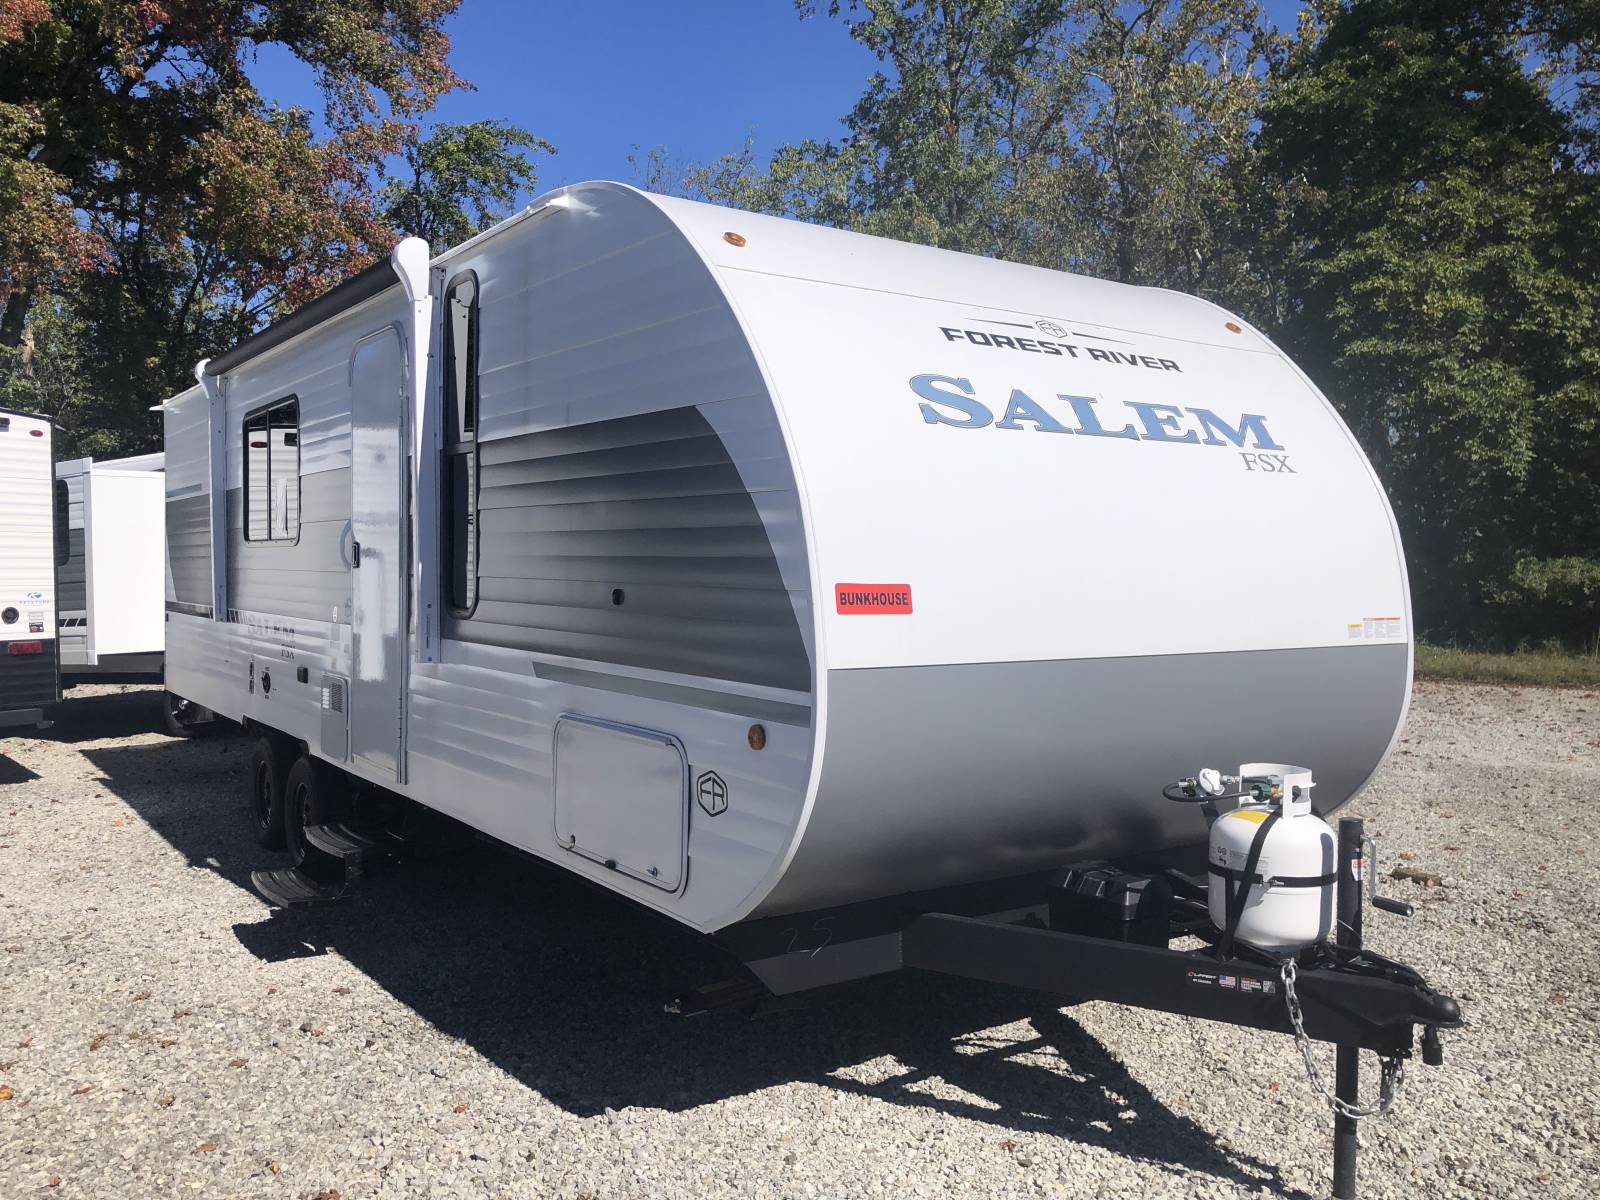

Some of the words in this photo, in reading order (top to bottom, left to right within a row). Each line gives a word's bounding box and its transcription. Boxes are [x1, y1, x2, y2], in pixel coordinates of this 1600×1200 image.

[938, 326, 1078, 358] FOREST
[1084, 347, 1184, 373] RIVER
[908, 373, 1286, 451] SALEM
[1239, 452, 1297, 474] FSX
[839, 592, 909, 606] BUNKHOUSE
